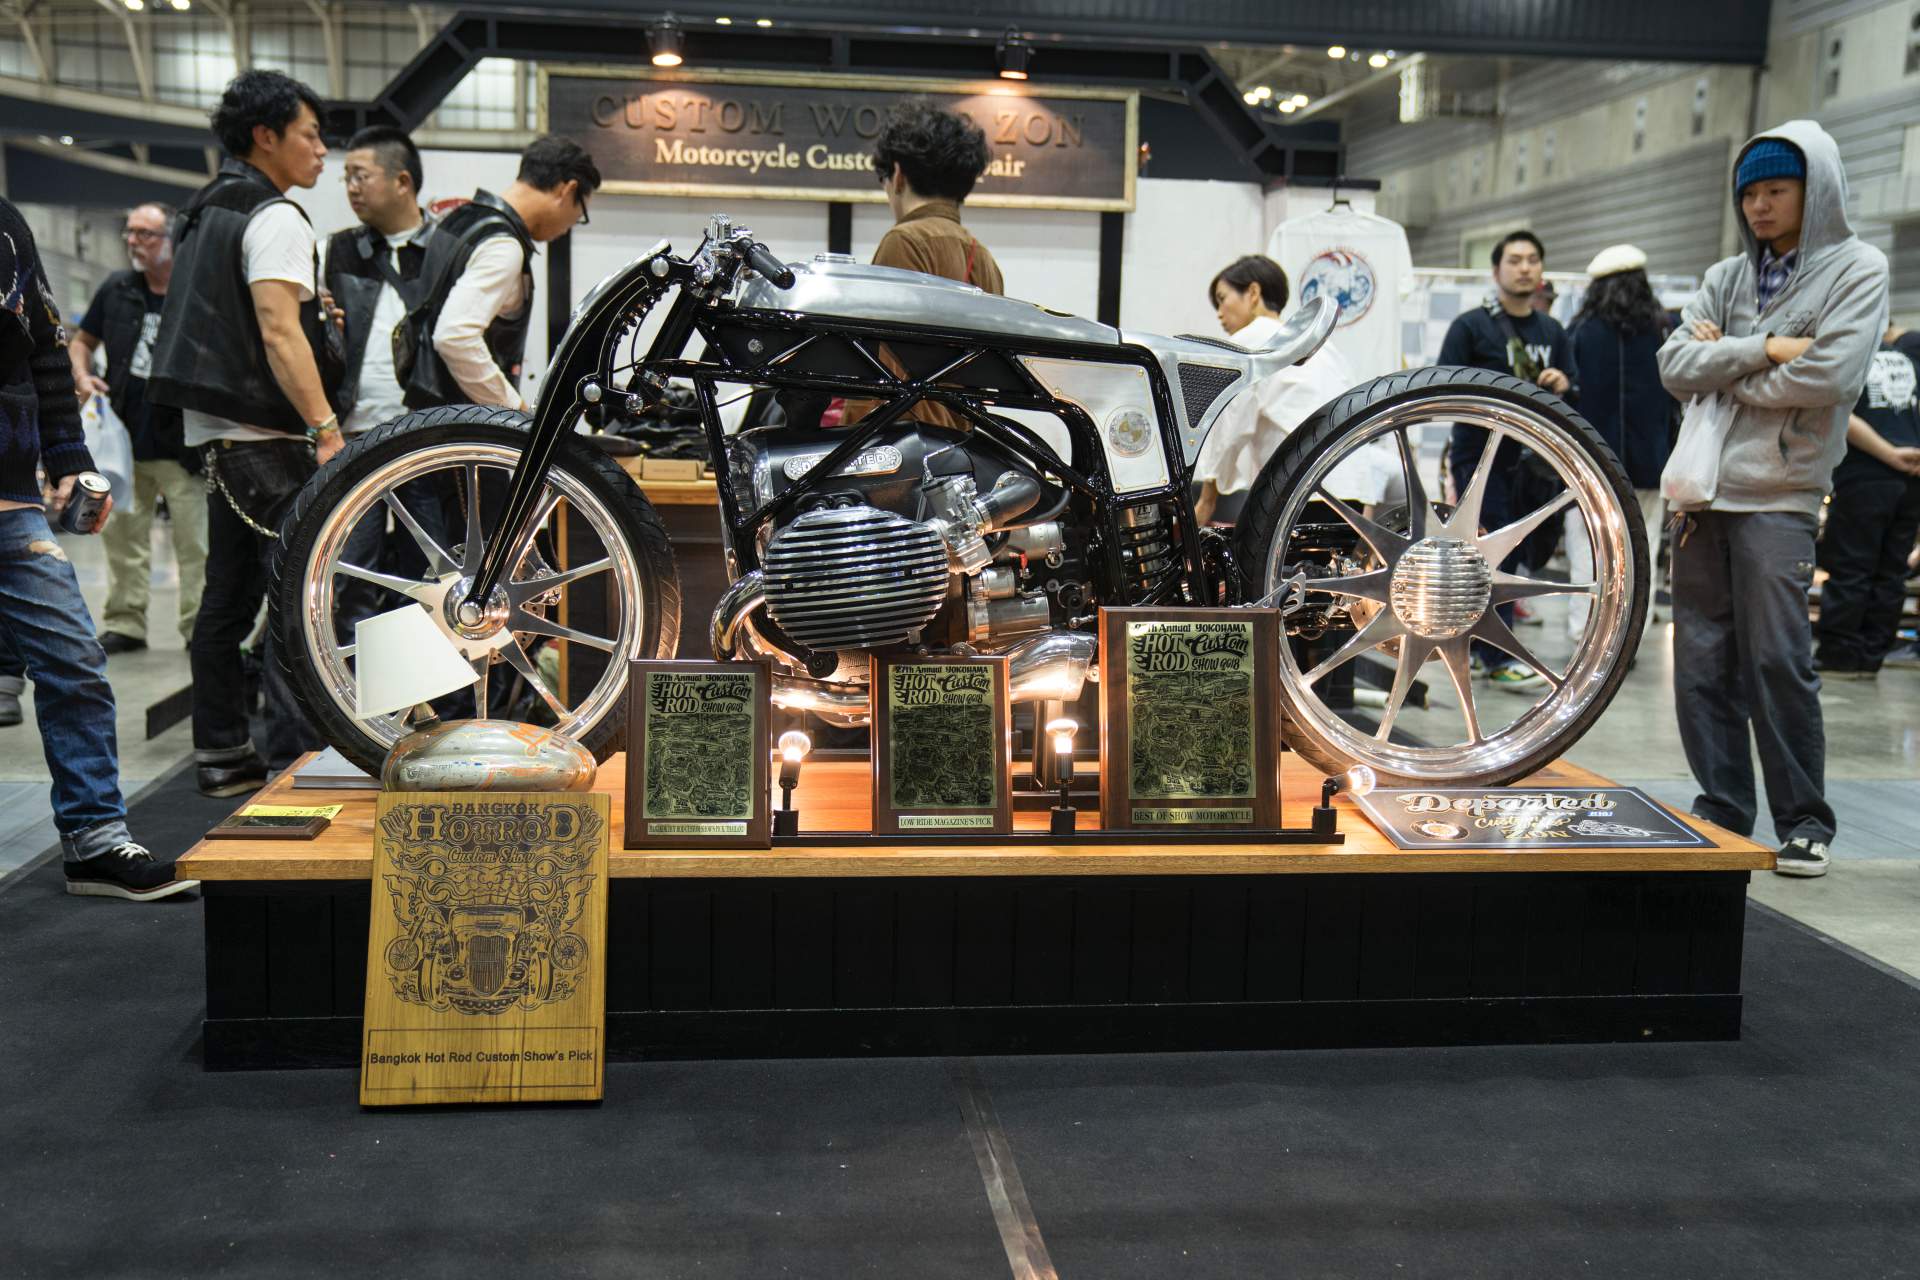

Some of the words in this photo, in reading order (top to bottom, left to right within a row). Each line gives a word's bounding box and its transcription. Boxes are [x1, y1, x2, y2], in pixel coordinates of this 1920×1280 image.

[591, 94, 785, 136] CUSTOM
[995, 111, 1086, 149] ZON
[655, 138, 799, 174] Motorcycle
[1159, 623, 1191, 632] Annual
[1195, 623, 1247, 632] YOKOHAMA
[1142, 633, 1184, 652] HOT
[1185, 632, 1249, 658] Custom
[1147, 652, 1190, 671] ROD
[1191, 657, 1219, 670] SHOW
[653, 674, 672, 682] 27th
[674, 674, 702, 682] Annual
[705, 674, 750, 682] YOKOHAMA
[900, 674, 936, 690] HOT
[937, 673, 991, 694] Custom
[659, 682, 695, 698] HOT
[696, 682, 752, 703] Custom
[904, 689, 940, 704] ROD
[943, 694, 966, 704] SHOW
[662, 697, 699, 713] ROD
[701, 702, 725, 713] SHOW
[452, 803, 540, 815] BANGKOK
[1396, 792, 1617, 817] Departed
[900, 818, 914, 826] LOW
[916, 818, 933, 826] RIDE
[934, 817, 974, 826] MAGAZINE'S
[975, 817, 992, 825] PICK
[1134, 811, 1154, 821] BEST
[1156, 811, 1168, 821] OF
[1169, 811, 1194, 821] SHOW
[1197, 810, 1251, 820] MOTORCYCLE
[405, 804, 582, 845] HOTROD
[448, 846, 496, 863] Custom
[499, 846, 537, 863] Show
[370, 1053, 421, 1065] Bangkok
[425, 1052, 445, 1063] Hot
[449, 1051, 472, 1062] Rod
[476, 1051, 520, 1062] Custom
[524, 1050, 564, 1061] Show's
[568, 1050, 593, 1061] Pick
